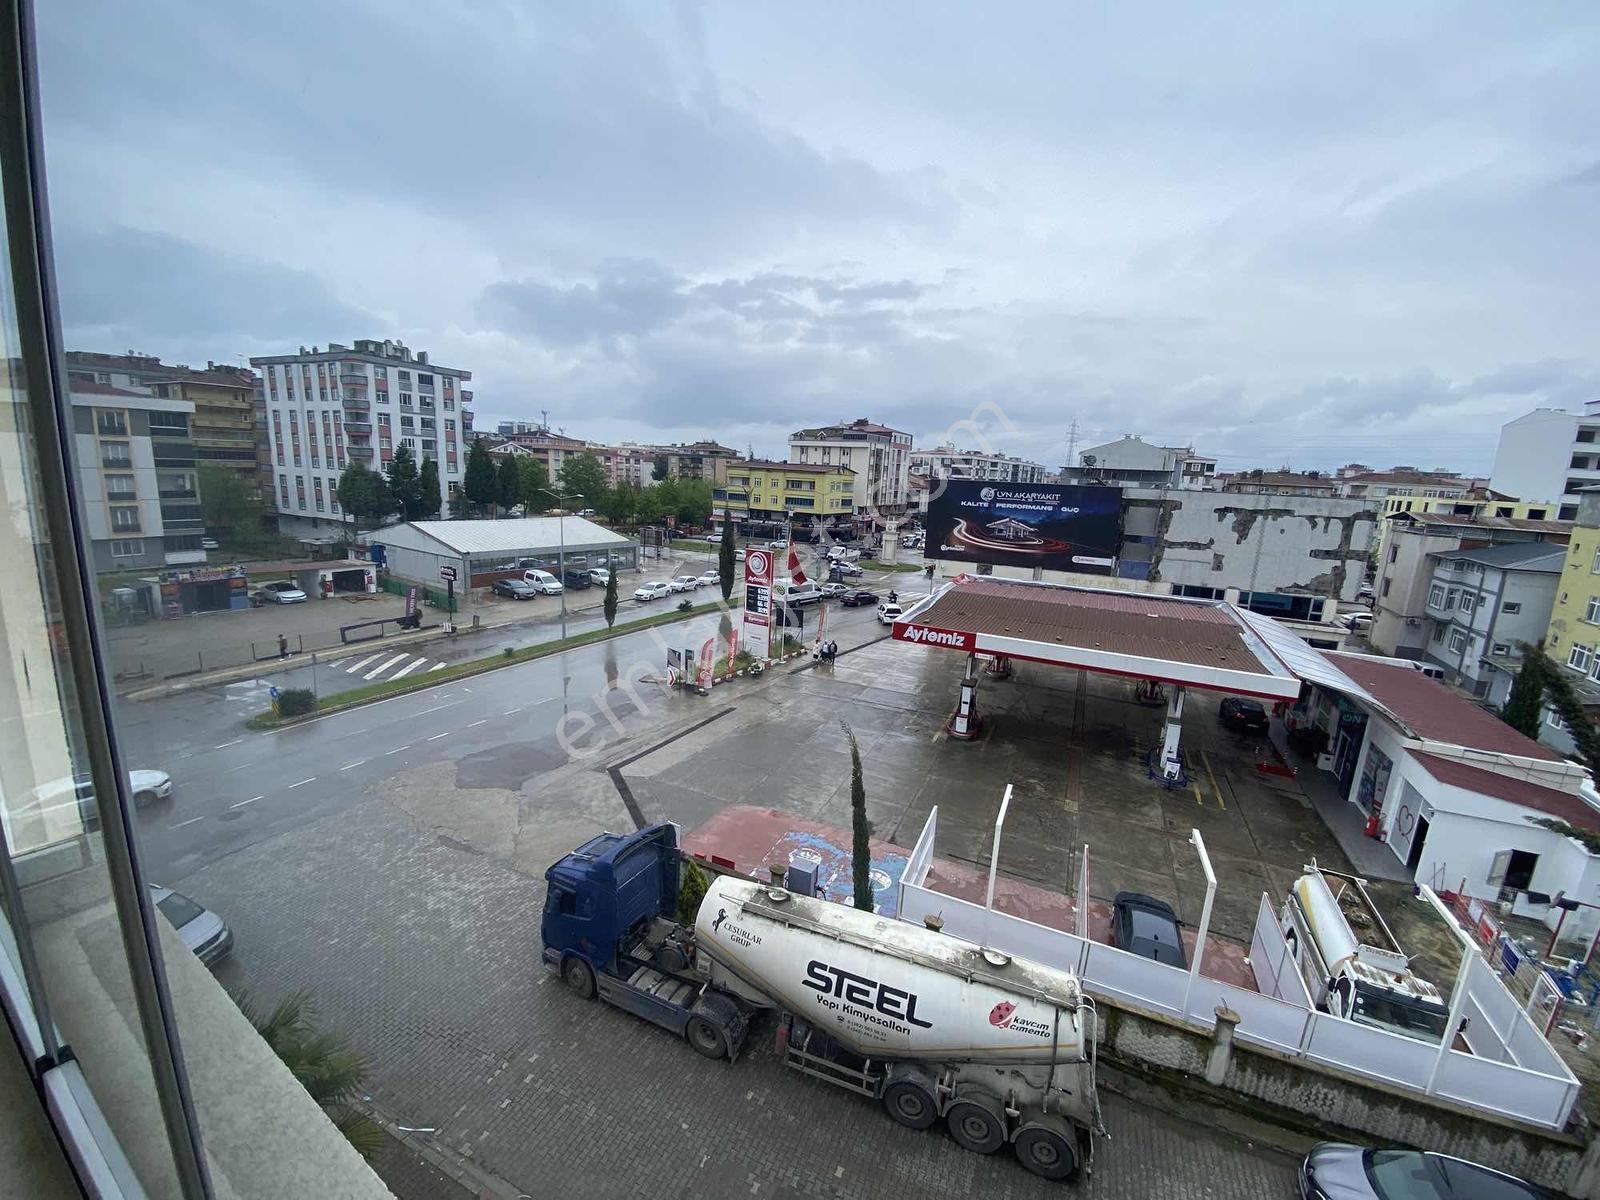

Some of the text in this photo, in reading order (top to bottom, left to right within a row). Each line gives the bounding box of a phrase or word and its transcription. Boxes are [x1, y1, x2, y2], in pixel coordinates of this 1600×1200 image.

[995, 503, 1053, 511] PERFORMANS
[1014, 492, 1061, 500] AKARYAKIT
[902, 625, 965, 648] Aytemiz
[723, 922, 763, 945] CESURLAR
[730, 934, 751, 948] GRUP
[801, 959, 934, 1029] STEEL
[842, 1003, 911, 1036] Kimyasalları
